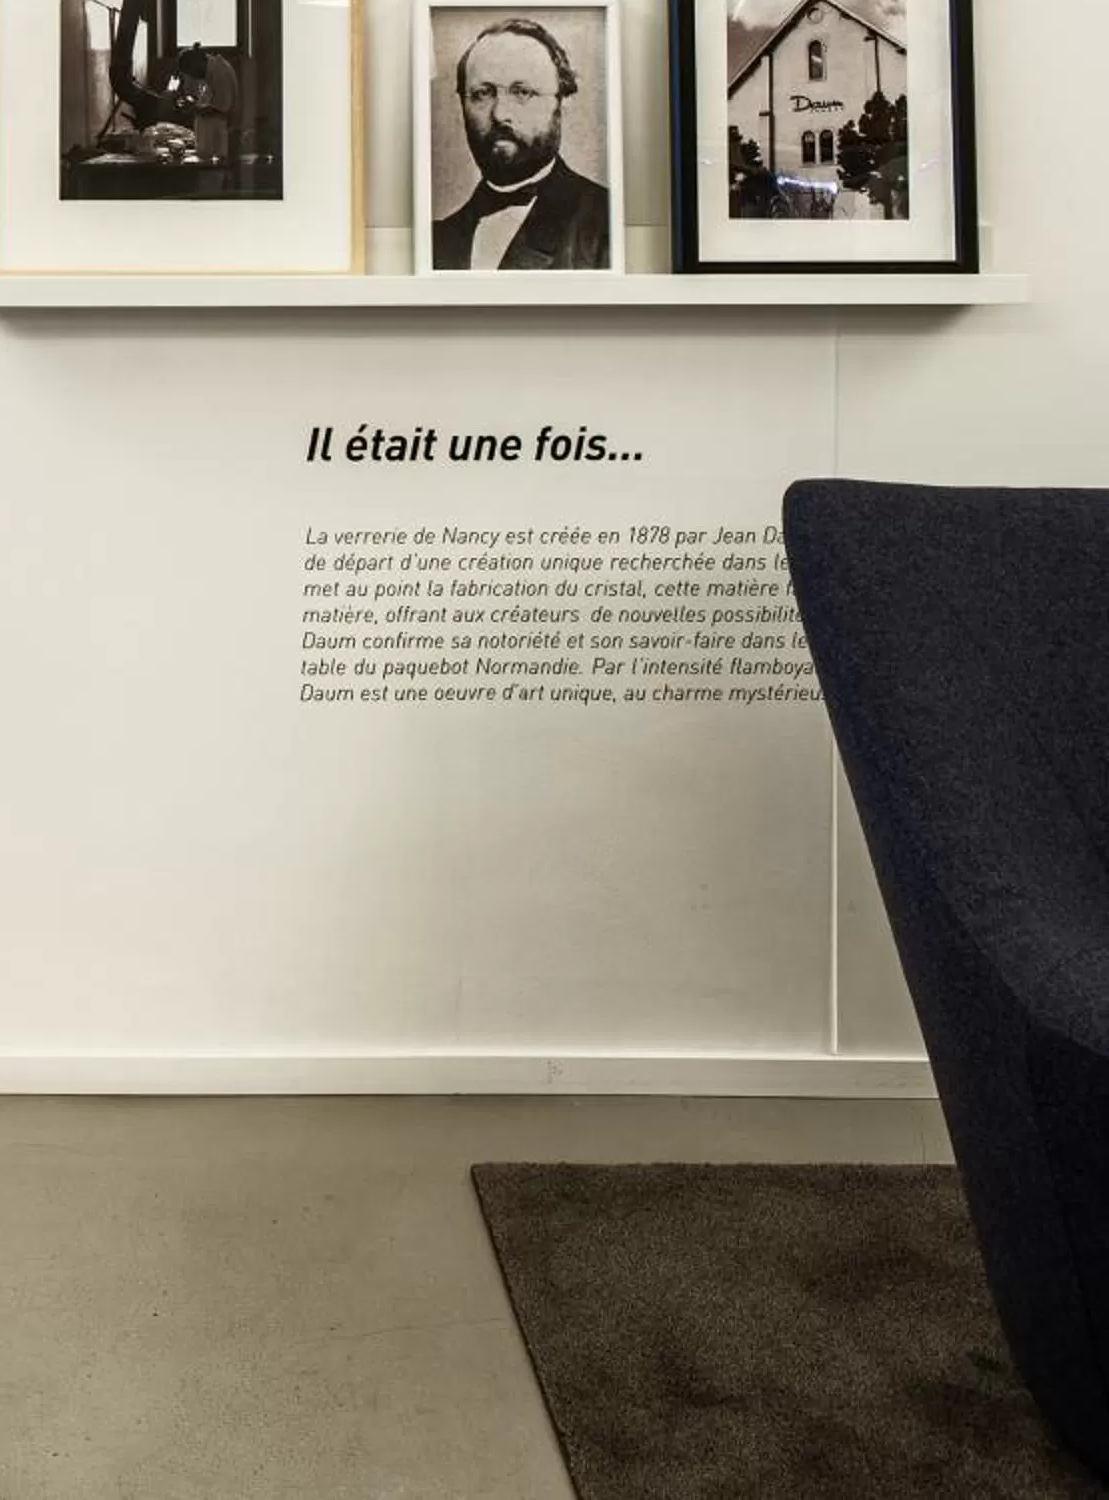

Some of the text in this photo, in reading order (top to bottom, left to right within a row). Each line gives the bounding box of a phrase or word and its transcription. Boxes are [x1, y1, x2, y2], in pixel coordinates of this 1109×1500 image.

[789, 95, 845, 113] Daum
[306, 423, 642, 462] Il était une fois...
[305, 526, 328, 545] La
[334, 530, 408, 545] verrerie
[412, 526, 436, 545] de
[441, 526, 500, 549] Nancy
[504, 528, 534, 545] est
[538, 525, 592, 544] créée
[597, 530, 620, 544] en
[629, 525, 670, 544] 1878
[674, 530, 708, 549] par
[712, 525, 756, 545] Jean
[302, 581, 340, 597] met
[344, 583, 368, 597] au
[373, 580, 421, 601] point
[426, 579, 444, 597] la
[450, 578, 548, 597] fabrication
[554, 579, 578, 597] du
[583, 579, 646, 599] cristal,
[654, 579, 700, 597] cette
[706, 577, 779, 597] matière
[301, 631, 356, 649] Daum
[362, 631, 444, 649] confirme
[450, 635, 472, 649] sa
[477, 629, 560, 649] notoriété
[566, 632, 584, 649] et
[589, 635, 623, 649] son
[628, 630, 736, 649] savoir-faire
[740, 631, 785, 649] dans
[300, 657, 346, 675] table
[353, 657, 376, 675] du
[381, 657, 469, 680] paquebot
[474, 656, 582, 675] Normandie.
[591, 656, 625, 675] Par
[631, 656, 722, 675] l'intensité
[299, 683, 354, 702] Daum
[359, 684, 388, 702] est
[394, 687, 428, 701] une
[433, 686, 496, 701] oeuvre
[501, 683, 544, 700] d'art
[550, 683, 616, 706] unique,
[622, 688, 646, 701] au
[651, 683, 723, 701] charme
